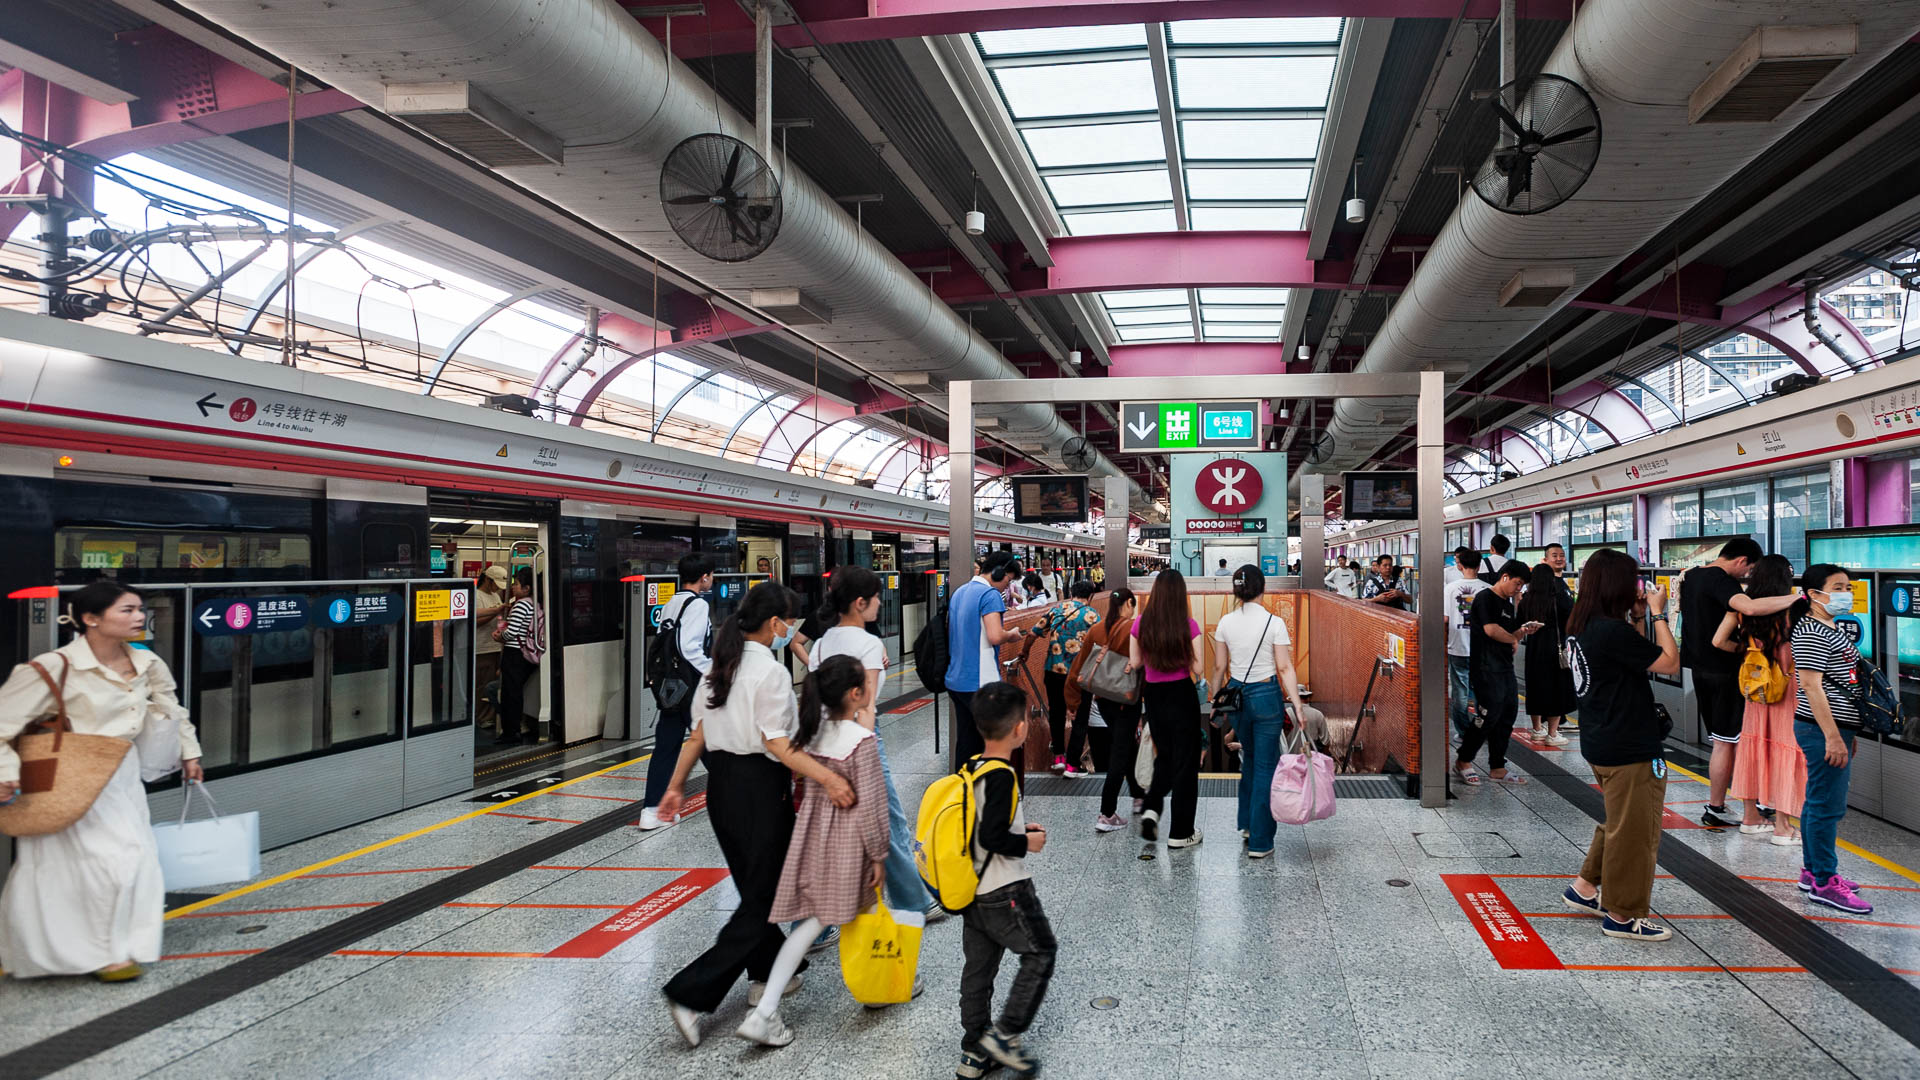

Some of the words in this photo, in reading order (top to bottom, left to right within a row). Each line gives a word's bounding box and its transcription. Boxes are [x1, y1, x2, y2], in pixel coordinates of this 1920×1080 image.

[241, 400, 249, 412] 1
[262, 403, 348, 428] 4号线往牛湖
[1166, 410, 1190, 431] 出
[257, 419, 275, 428] Line
[291, 424, 314, 433] Niuhu
[1213, 416, 1243, 428] 6号线
[1166, 431, 1190, 441] EXIT
[1761, 430, 1781, 444] 红山
[537, 446, 560, 460] 红山
[1764, 443, 1787, 453] Hongshan
[532, 458, 558, 467] Hongshan
[257, 600, 297, 611] 温度适中
[355, 596, 388, 606] 温度较低
[1477, 892, 1528, 942] 请在此排队候车
